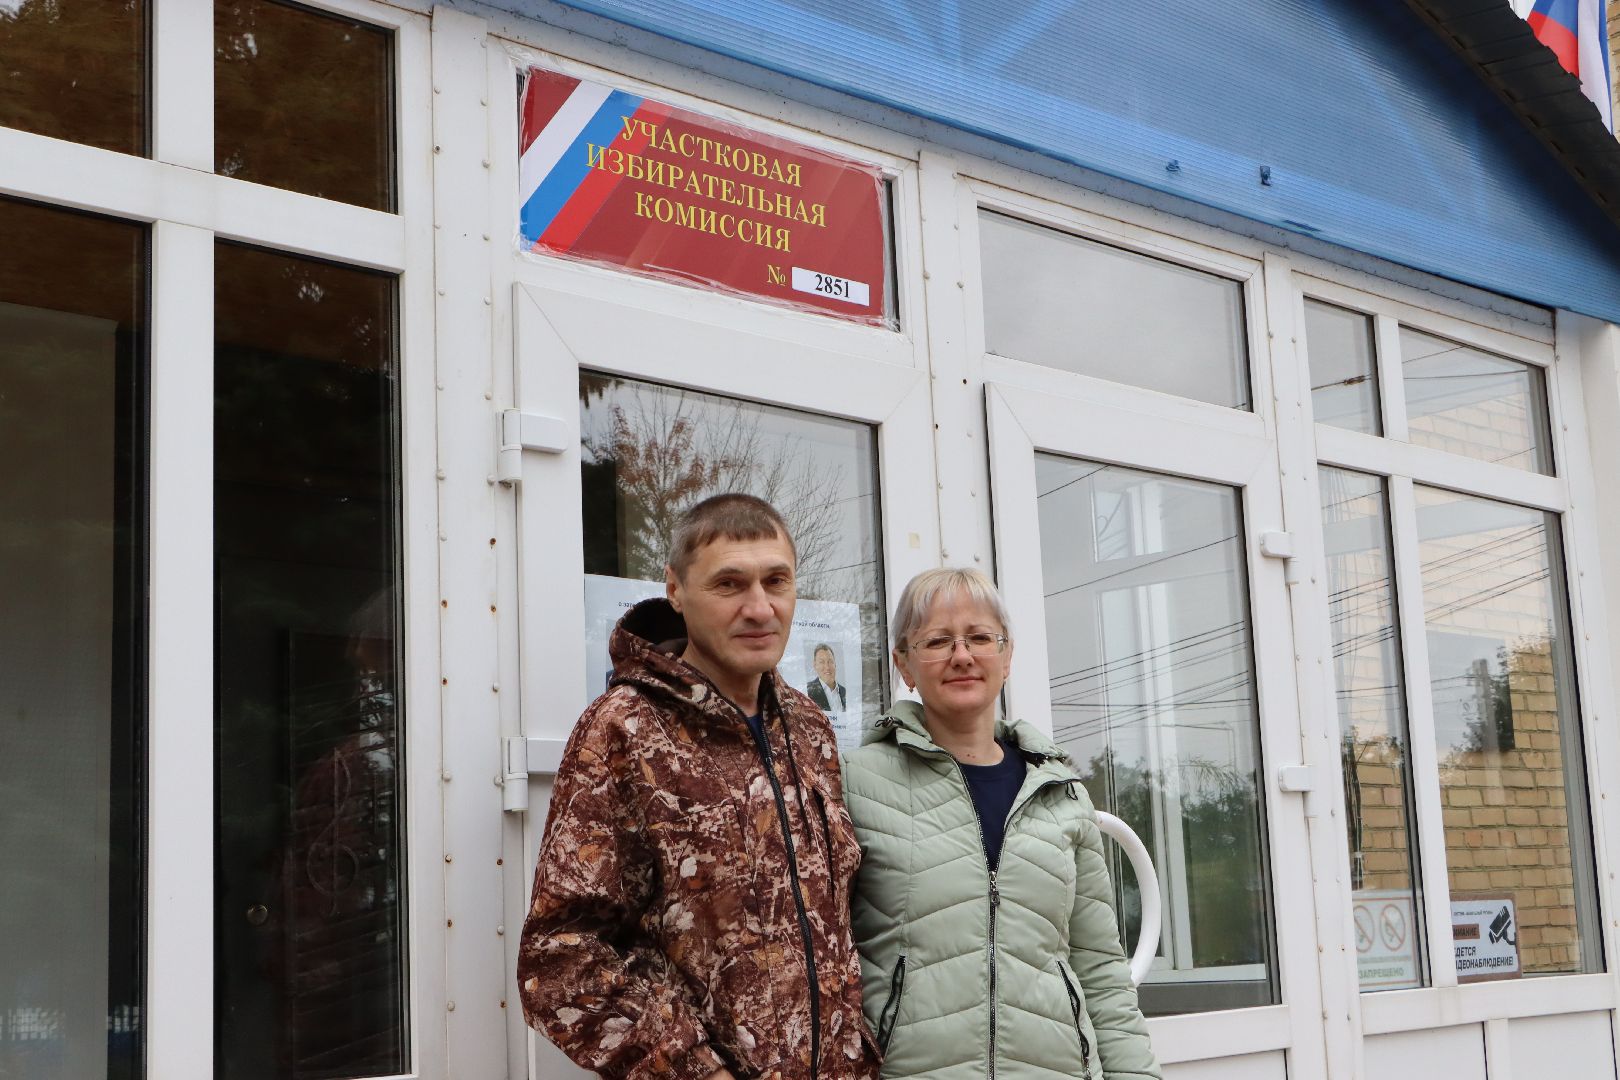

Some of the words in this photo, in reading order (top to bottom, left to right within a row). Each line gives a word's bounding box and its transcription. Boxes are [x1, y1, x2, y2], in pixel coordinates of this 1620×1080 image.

[621, 115, 802, 187] УЧАСТКОВАЯ
[585, 142, 827, 228] ИЗБИРАТЕЛЬНАЯ
[634, 191, 791, 252] КОМИССИЯ
[767, 264, 786, 286] №
[815, 273, 850, 298] 2851
[1454, 946, 1476, 958] ДЕТСЯ
